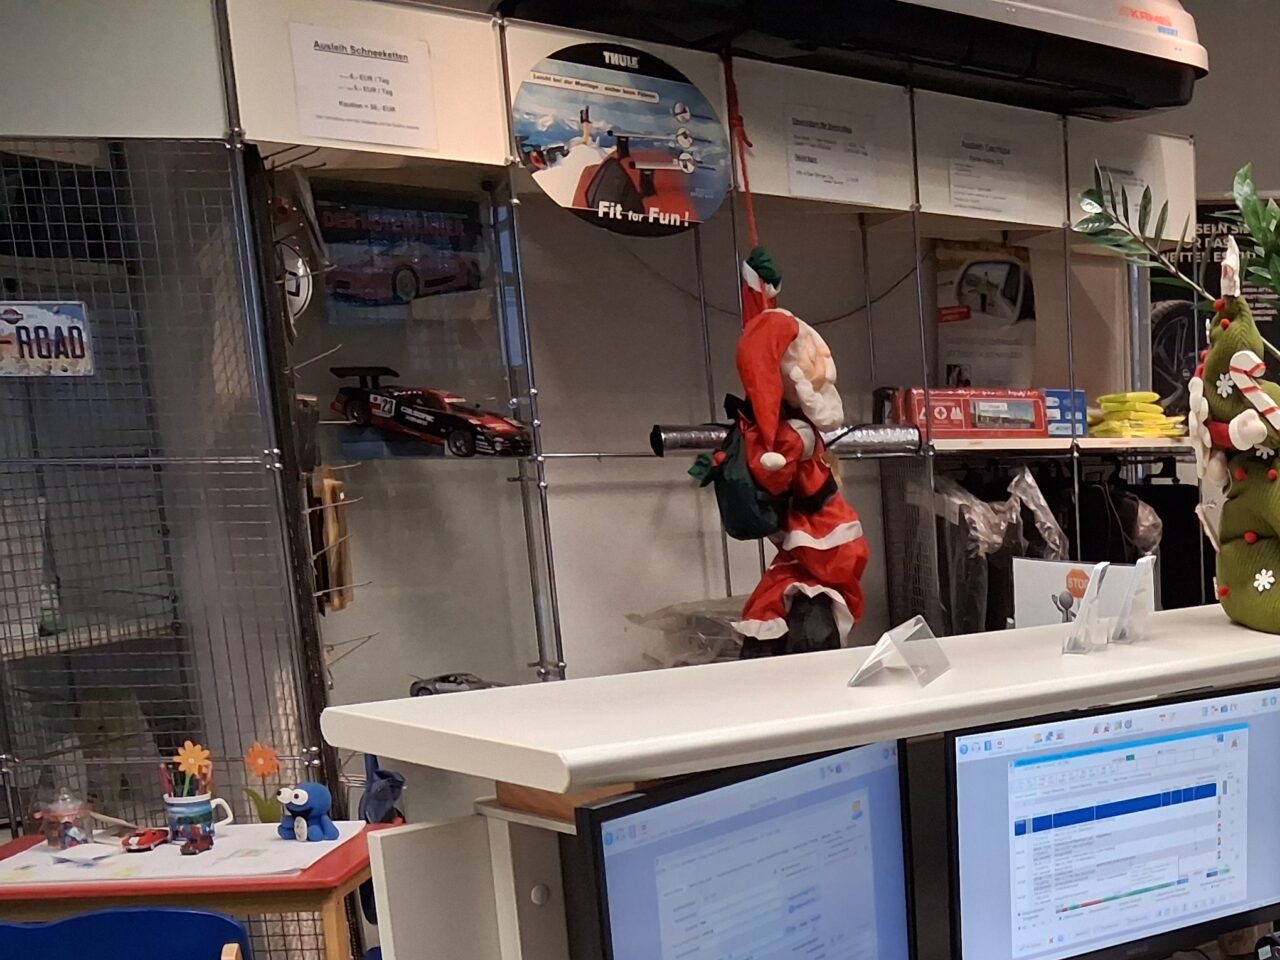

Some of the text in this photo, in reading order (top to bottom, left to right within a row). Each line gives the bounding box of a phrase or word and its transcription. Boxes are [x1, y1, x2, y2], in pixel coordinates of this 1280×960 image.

[314, 40, 409, 62] Ausleih Schneeketten
[602, 51, 640, 69] THULE
[598, 200, 623, 220] Fit
[627, 210, 644, 222] for
[1067, 577, 1089, 588] STOP
